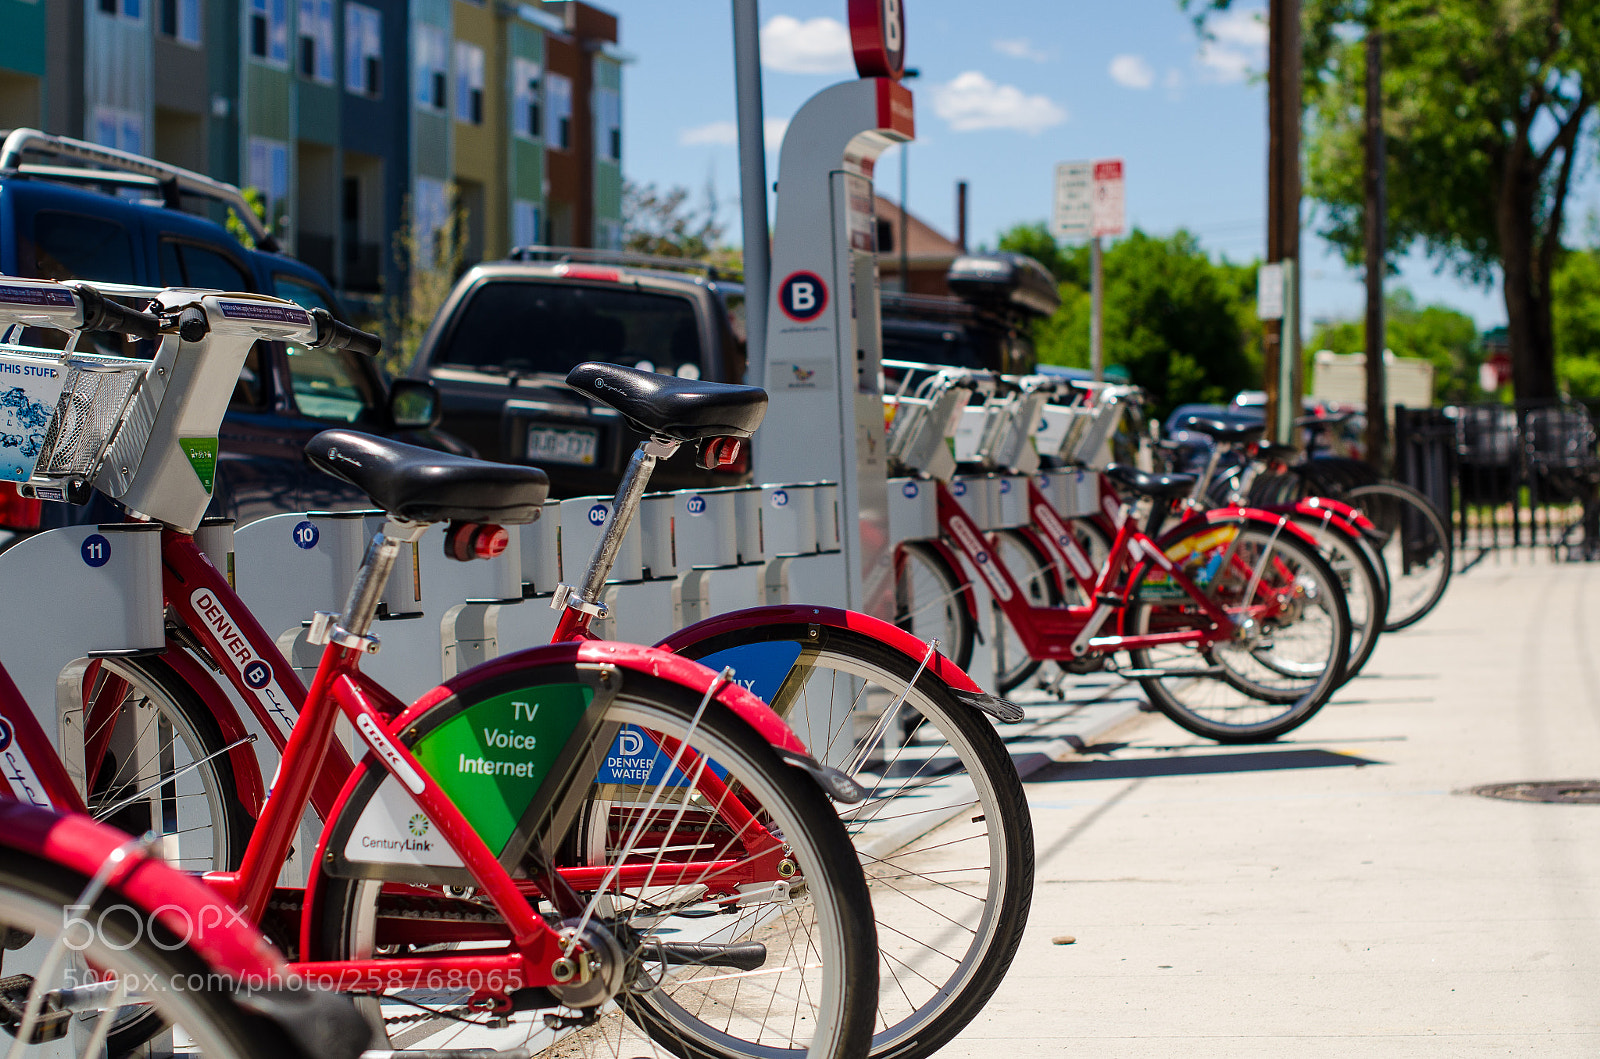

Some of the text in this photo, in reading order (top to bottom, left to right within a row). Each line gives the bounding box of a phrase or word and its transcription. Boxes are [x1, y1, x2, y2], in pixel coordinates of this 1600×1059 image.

[884, 0, 900, 51] B
[792, 282, 816, 310] B
[590, 510, 606, 522] 08
[688, 502, 703, 512] 07
[296, 528, 314, 543] 10
[87, 543, 103, 559] 11
[196, 594, 252, 665] DENVER
[511, 702, 539, 722] TV
[362, 718, 400, 764] TREK
[484, 728, 537, 750] Voice
[458, 753, 535, 778] Internet
[607, 757, 654, 769] DENVER
[611, 768, 650, 780] WATER
[361, 836, 431, 852] CenturyLink
